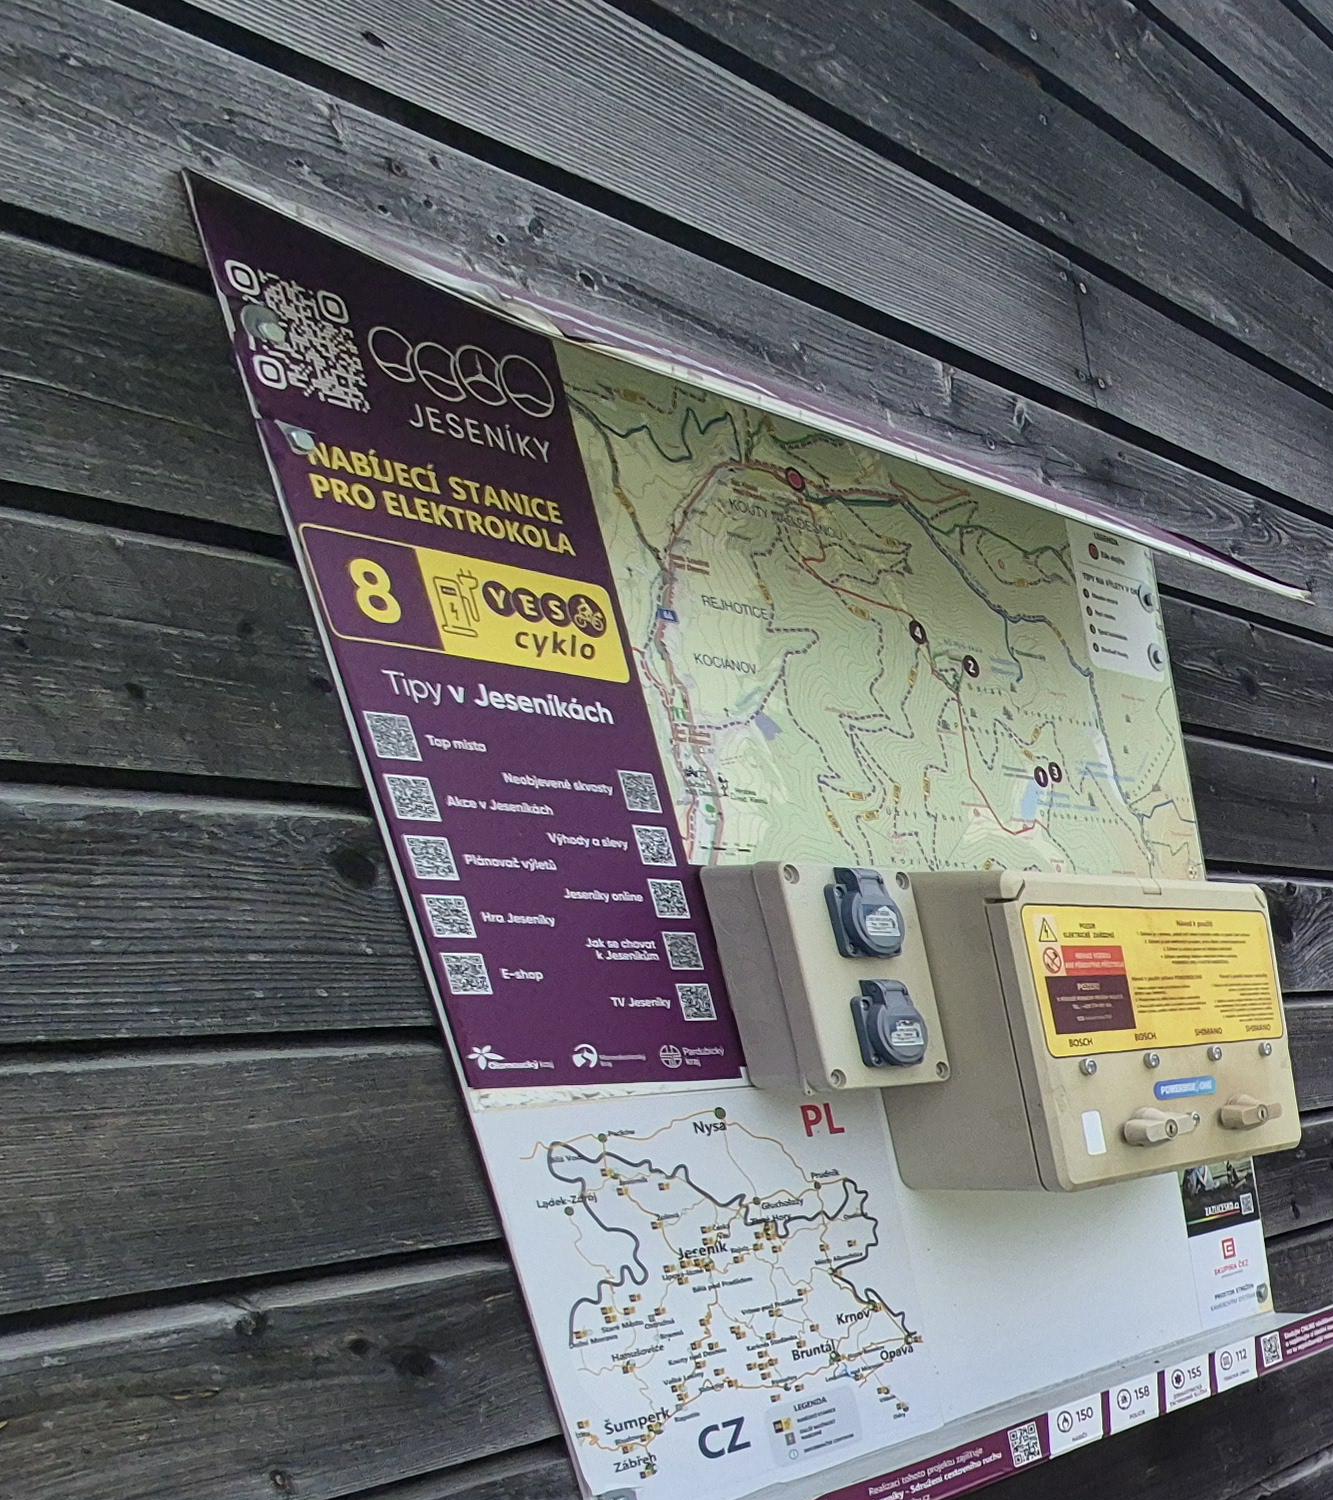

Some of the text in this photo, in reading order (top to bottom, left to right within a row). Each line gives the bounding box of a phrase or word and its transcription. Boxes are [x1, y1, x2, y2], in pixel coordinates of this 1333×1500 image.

[409, 403, 550, 463] JESENÍKY
[308, 442, 563, 525] NABÍJECÍ STANICE
[309, 473, 576, 557] PRO ELEKTROKOLA
[349, 558, 402, 624] 8
[485, 583, 567, 623] YES
[701, 594, 769, 620] REJHOTICE
[515, 629, 596, 660] cyklo
[693, 652, 757, 674] KOCIANOV
[382, 668, 442, 706] Tipy
[448, 684, 464, 704] v
[425, 734, 487, 752] Top místa
[502, 771, 613, 796] Neobjevené skvosty
[447, 795, 475, 809] Akce
[489, 798, 554, 816] Jeseníkách
[547, 831, 591, 848] Výhody
[601, 836, 629, 851] slevy
[463, 852, 558, 873] Plánovač výletů
[564, 888, 644, 903] Jeseníky online
[481, 911, 556, 927] Hra Jeseníky
[586, 937, 605, 949] Jak
[620, 937, 657, 950] chovat
[501, 967, 544, 982] E-shop
[610, 996, 672, 1010] TV Jeseníky
[1069, 1038, 1093, 1047] BOSCH
[1135, 1032, 1157, 1041] BOSCH
[693, 1121, 727, 1137] Nysa
[800, 1102, 845, 1138] PL
[679, 1241, 729, 1260] Jeseník
[836, 1309, 870, 1325] Krnov
[611, 1344, 665, 1362] Hanušovice
[792, 1339, 836, 1361] Bruntál
[880, 1344, 914, 1361] Opava
[1235, 1348, 1247, 1362] 112
[1187, 1366, 1202, 1380] 155
[1134, 1385, 1150, 1401] 158
[604, 1407, 672, 1435] Šumperk
[1075, 1406, 1094, 1423] 150
[698, 1416, 752, 1459] CZ
[613, 1454, 658, 1473] Zábřeh
[982, 1451, 1002, 1465] ruchu
[868, 1478, 900, 1496] Realizaci
[901, 1469, 926, 1484] tohoto
[927, 1459, 955, 1475] projektu
